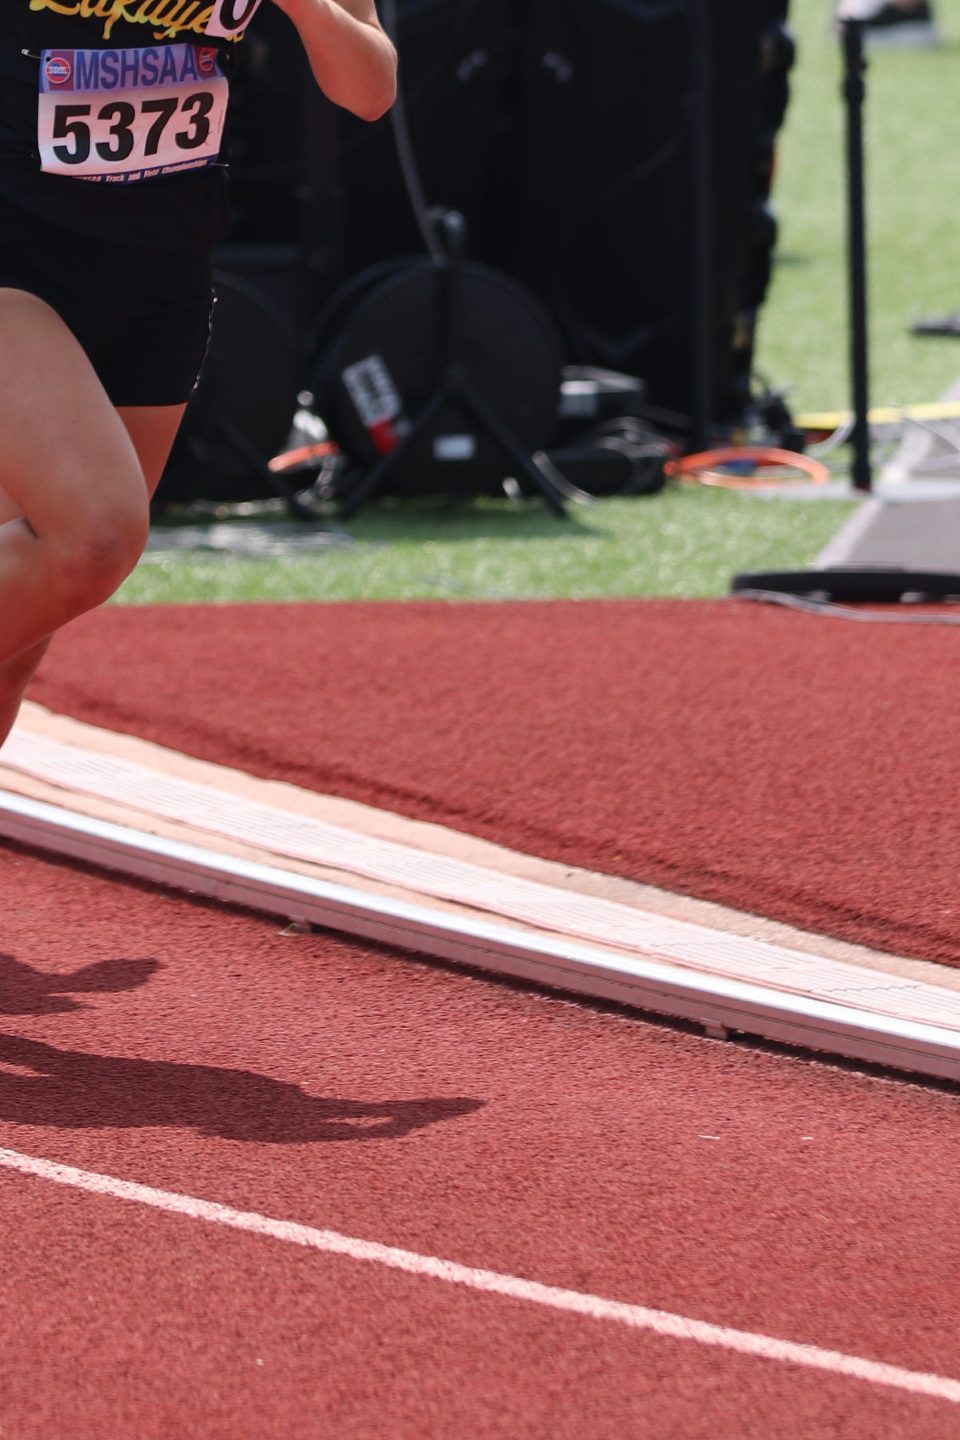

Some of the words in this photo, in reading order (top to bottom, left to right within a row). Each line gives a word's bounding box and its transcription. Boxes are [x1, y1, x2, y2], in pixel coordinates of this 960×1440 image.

[76, 46, 198, 90] MSHSAA
[52, 91, 214, 165] 5373
[105, 174, 125, 183] Track
[143, 166, 160, 179] Field
